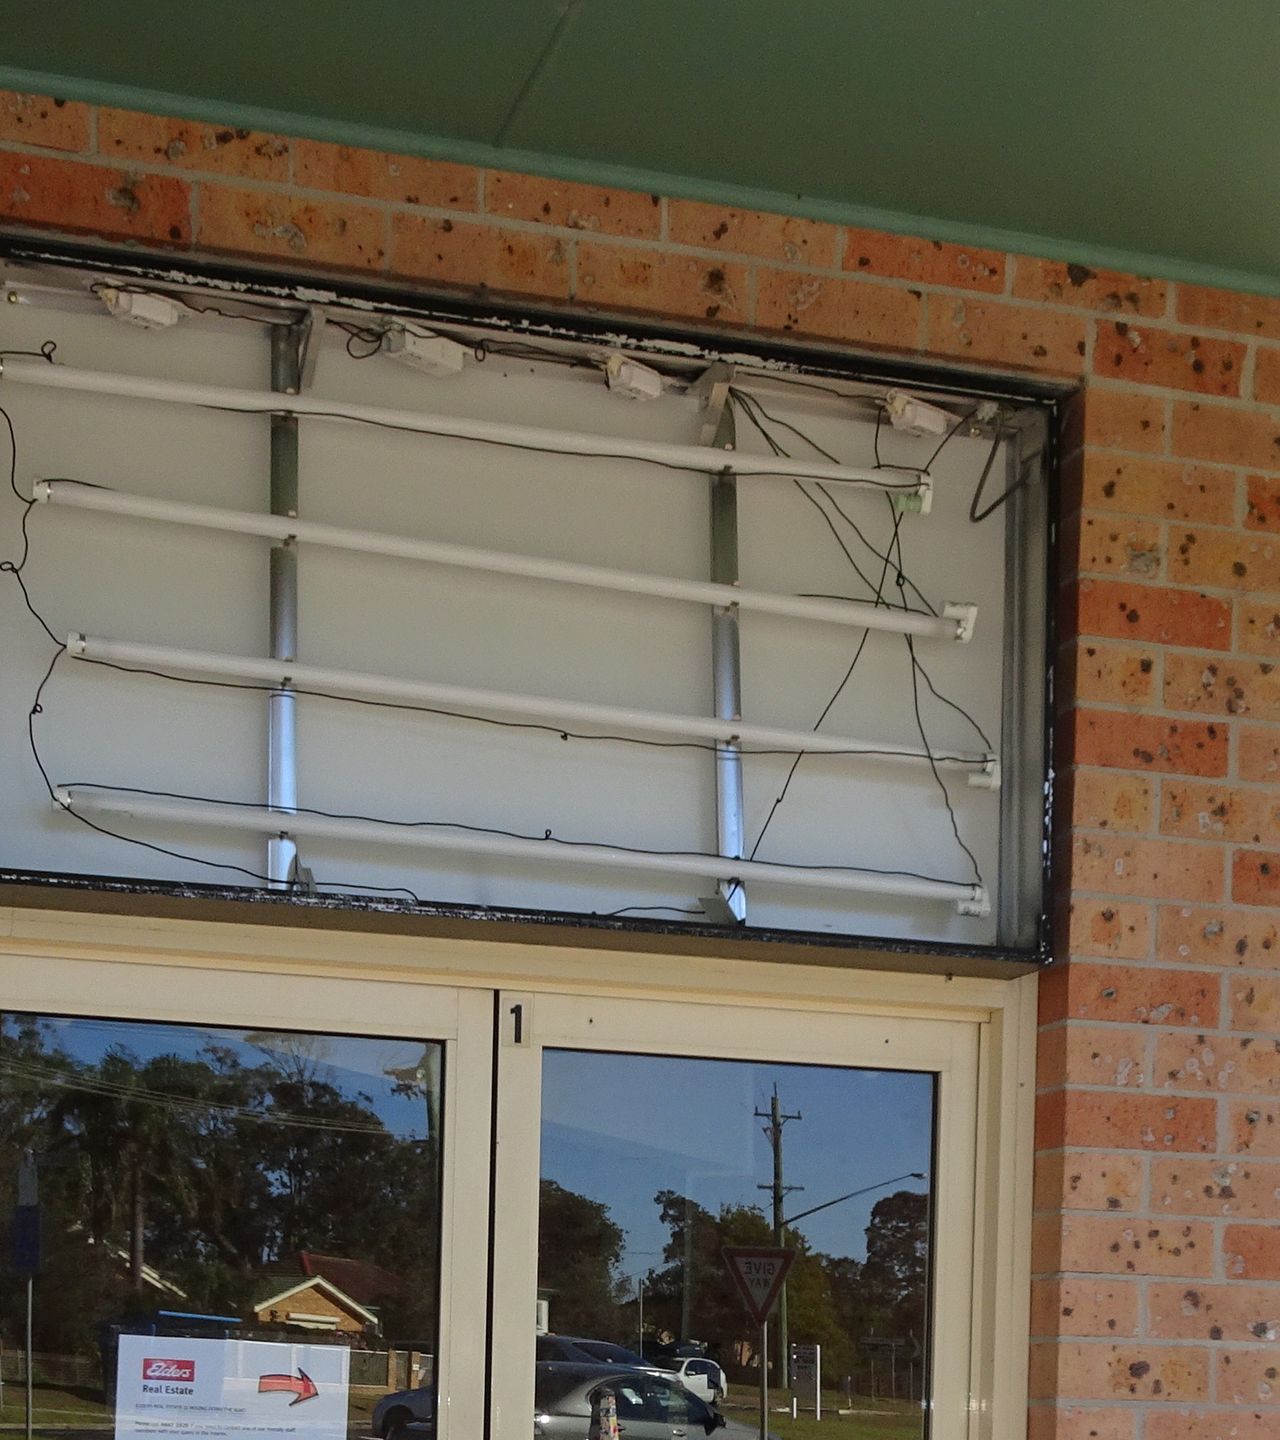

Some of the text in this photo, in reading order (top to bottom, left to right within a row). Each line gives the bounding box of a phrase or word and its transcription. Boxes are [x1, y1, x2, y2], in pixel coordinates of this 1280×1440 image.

[510, 1004, 522, 1043] 1
[146, 1361, 192, 1378] Elders
[142, 1384, 194, 1395] Real Estate
